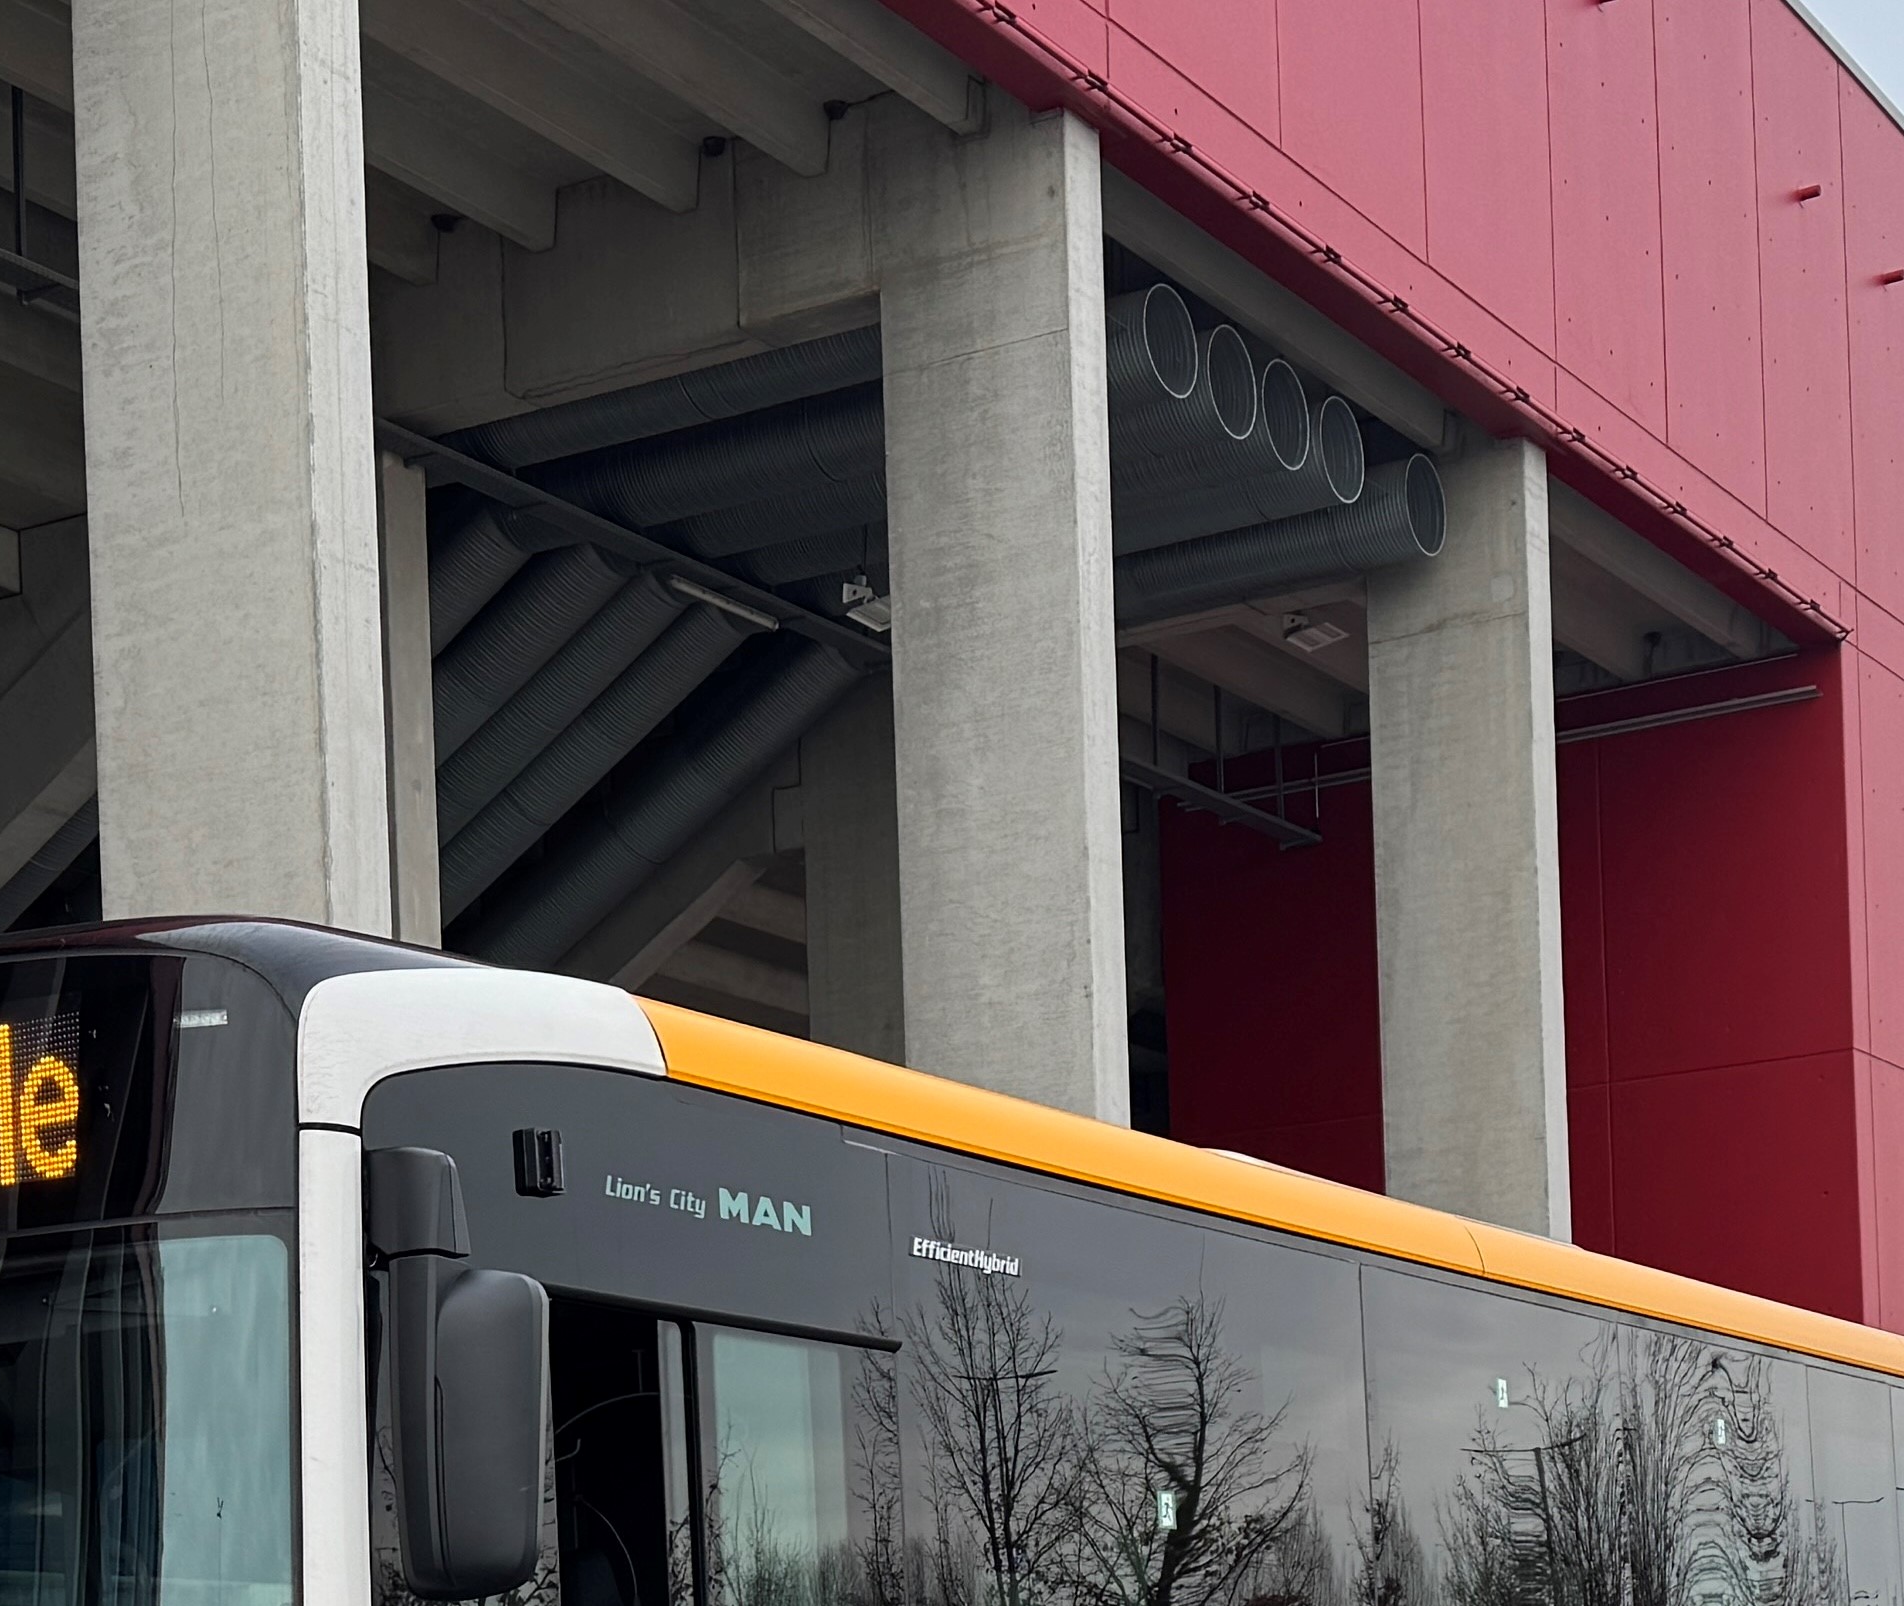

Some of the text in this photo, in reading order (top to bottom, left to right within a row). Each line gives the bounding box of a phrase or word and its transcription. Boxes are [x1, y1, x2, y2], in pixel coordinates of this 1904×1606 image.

[604, 1174, 812, 1237] Lion's City MAN
[912, 1236, 1020, 1278] EfficientHybrid
